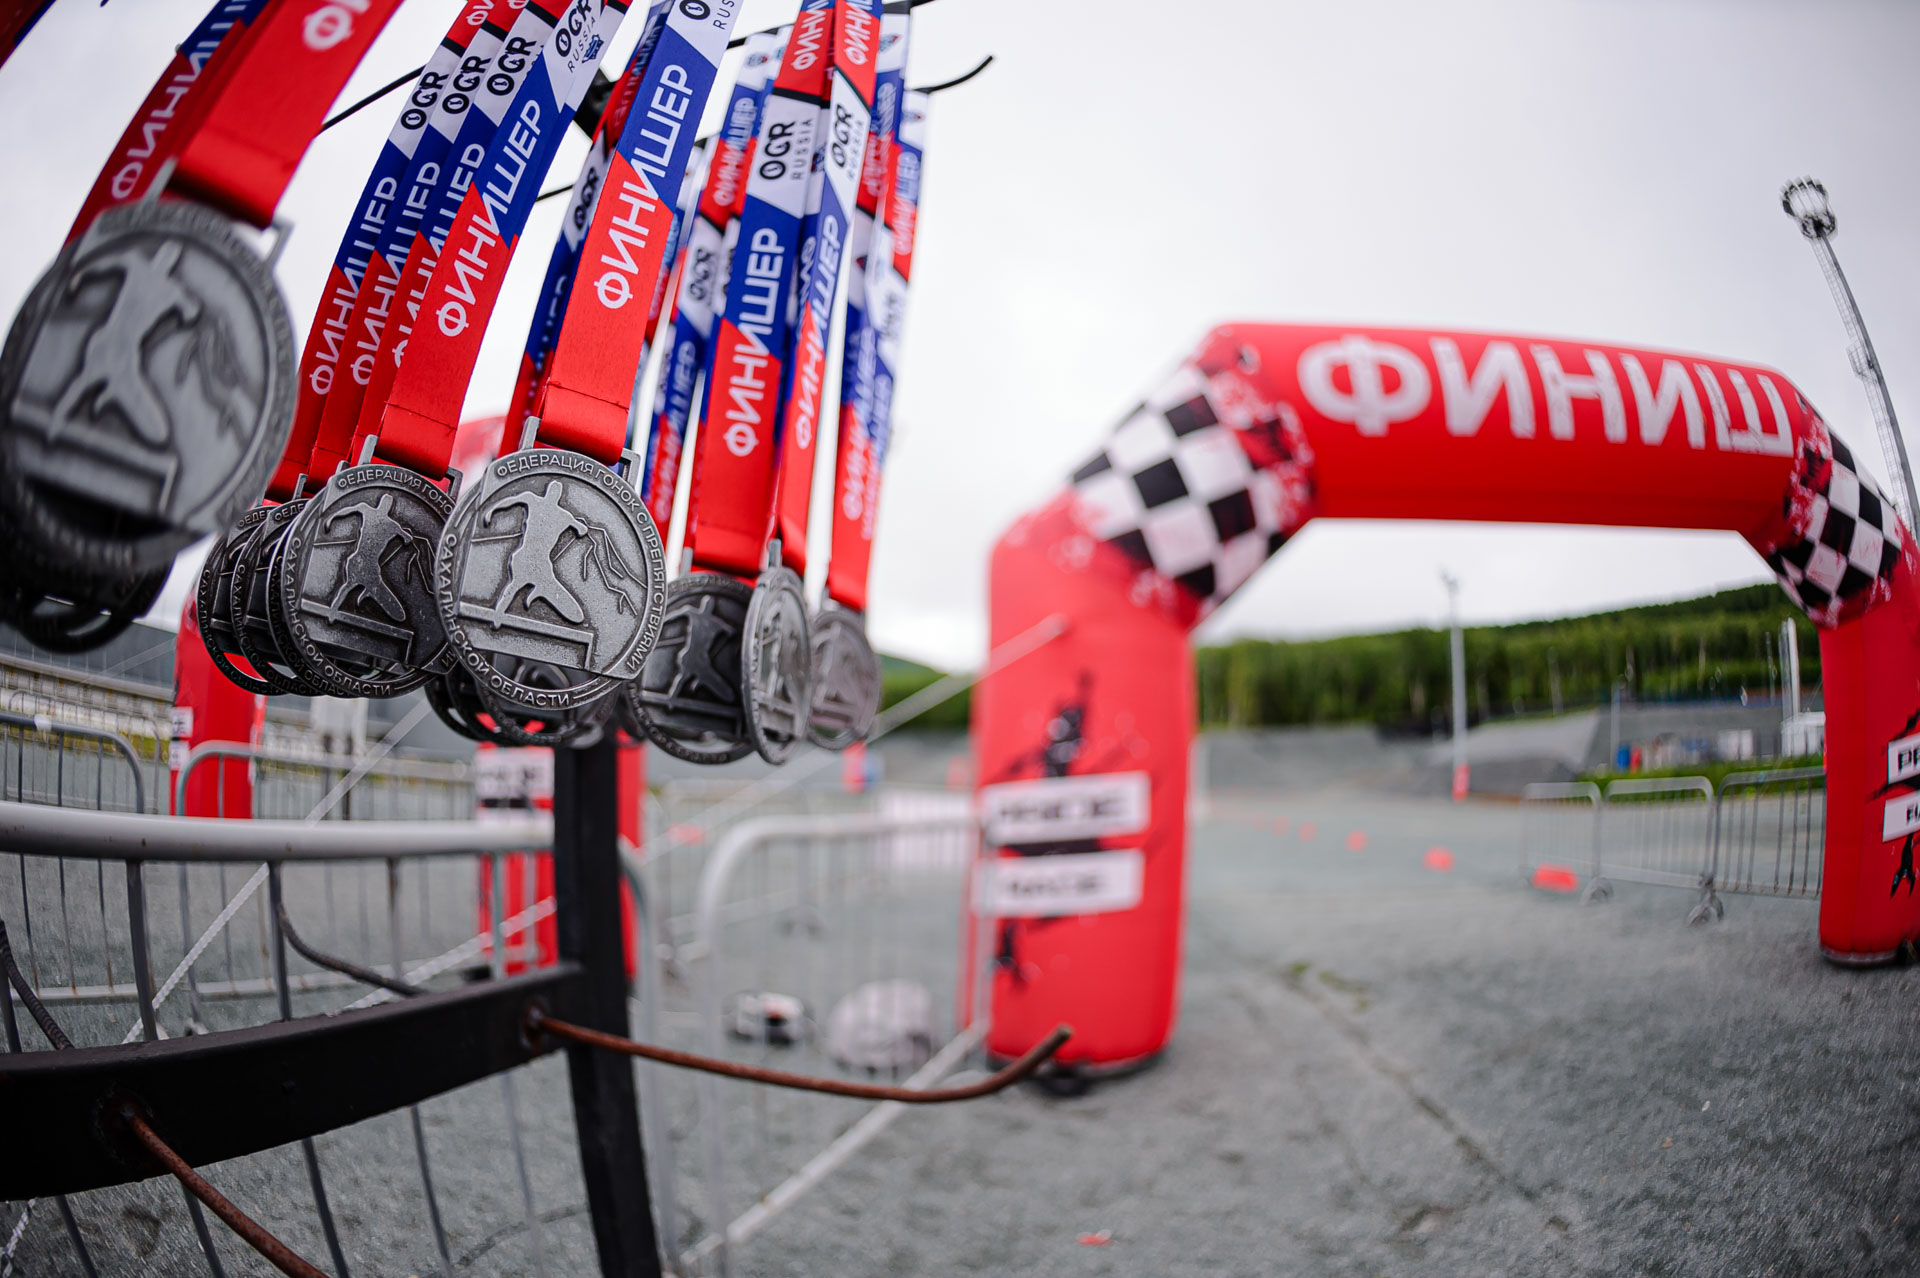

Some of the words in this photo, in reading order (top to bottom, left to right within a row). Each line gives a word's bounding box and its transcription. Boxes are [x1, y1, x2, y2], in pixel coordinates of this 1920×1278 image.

[487, 37, 537, 96] OGR
[567, 17, 596, 74] RUSSIA
[401, 72, 449, 130] OGR
[442, 56, 492, 114] OGR
[760, 121, 796, 180] OGR
[594, 64, 694, 309] ФИНИШЕР
[435, 99, 542, 337] ФИНИШЕР
[723, 228, 785, 458] ФИНИШЕР
[795, 214, 841, 450] ФИНИШЕР
[1296, 333, 1796, 459] ФИНИШ
[338, 469, 423, 489] ФЕДЕРАЦИЯ
[422, 484, 454, 515] ГОНО
[497, 453, 595, 478] ФЕДЕРАЦИЯ
[595, 466, 638, 512] ГОНОК
[637, 511, 649, 525] С
[286, 537, 324, 668] САХАЛИНСКОЙ
[324, 665, 392, 696] ОБЛАСТИ
[440, 533, 490, 671] САХАЛИНСКОЙ
[490, 675, 570, 707] ОБЛАСТИ
[627, 527, 665, 671] ПРЕПЯТСТВИЯМИ
